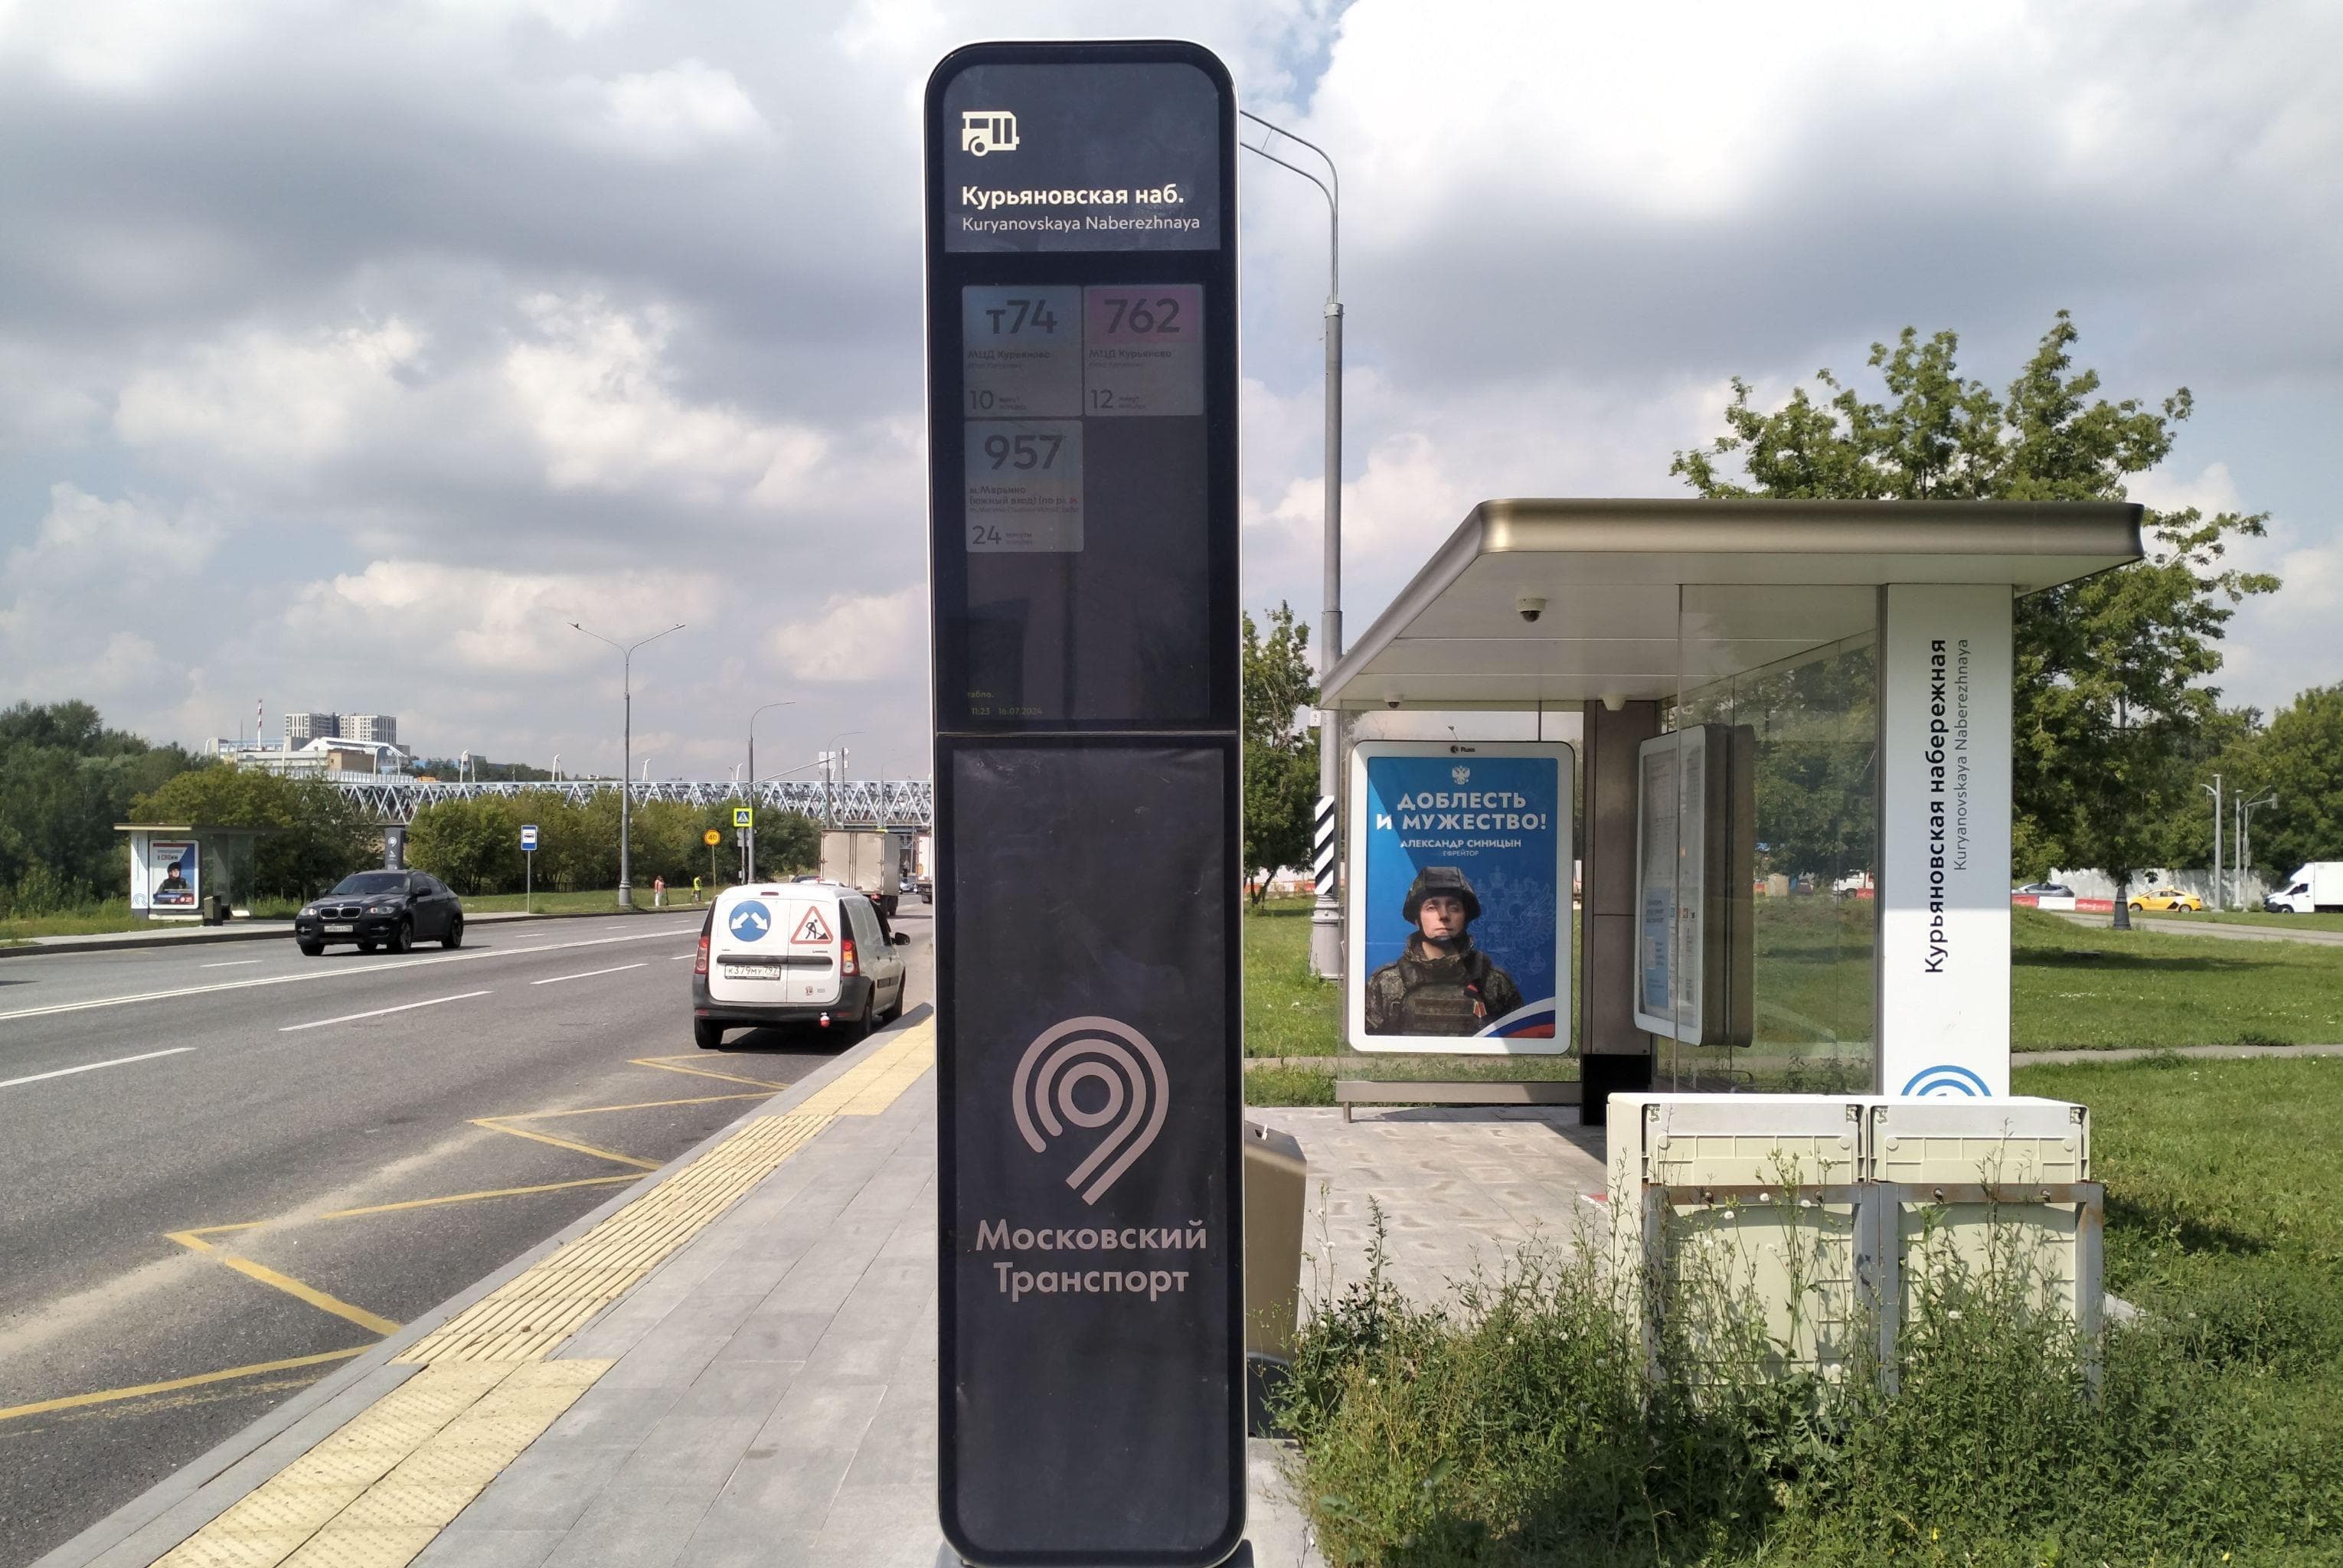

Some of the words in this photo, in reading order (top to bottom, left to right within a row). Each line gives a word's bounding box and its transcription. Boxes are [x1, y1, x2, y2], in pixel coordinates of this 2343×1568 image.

[962, 185, 1128, 210] Курьяновская
[1135, 184, 1185, 204] наб.
[962, 217, 1080, 234] Kuryanovskaya
[1086, 214, 1201, 232] Naberezhnaya
[1104, 297, 1181, 335] 762
[969, 390, 995, 409] 10
[1090, 389, 1115, 409] 12
[984, 434, 1064, 471] 957
[972, 524, 1002, 545] 24
[1954, 639, 1969, 751] Naberezhnaya
[1924, 639, 1949, 793] набережная
[1397, 792, 1527, 811] ДОБЛЕСТЬ
[1954, 756, 1969, 871] Kuryanovskaya
[1376, 813, 1393, 830] И
[1402, 813, 1547, 830] МУЖЕСТВО!
[1400, 839, 1464, 848] АЛЕКСАНДР
[1466, 839, 1521, 848] СИНИЦЫН
[1924, 800, 1949, 973] Курьяновская
[975, 1218, 1207, 1251] Московский
[993, 1261, 1189, 1302] Транспорт
